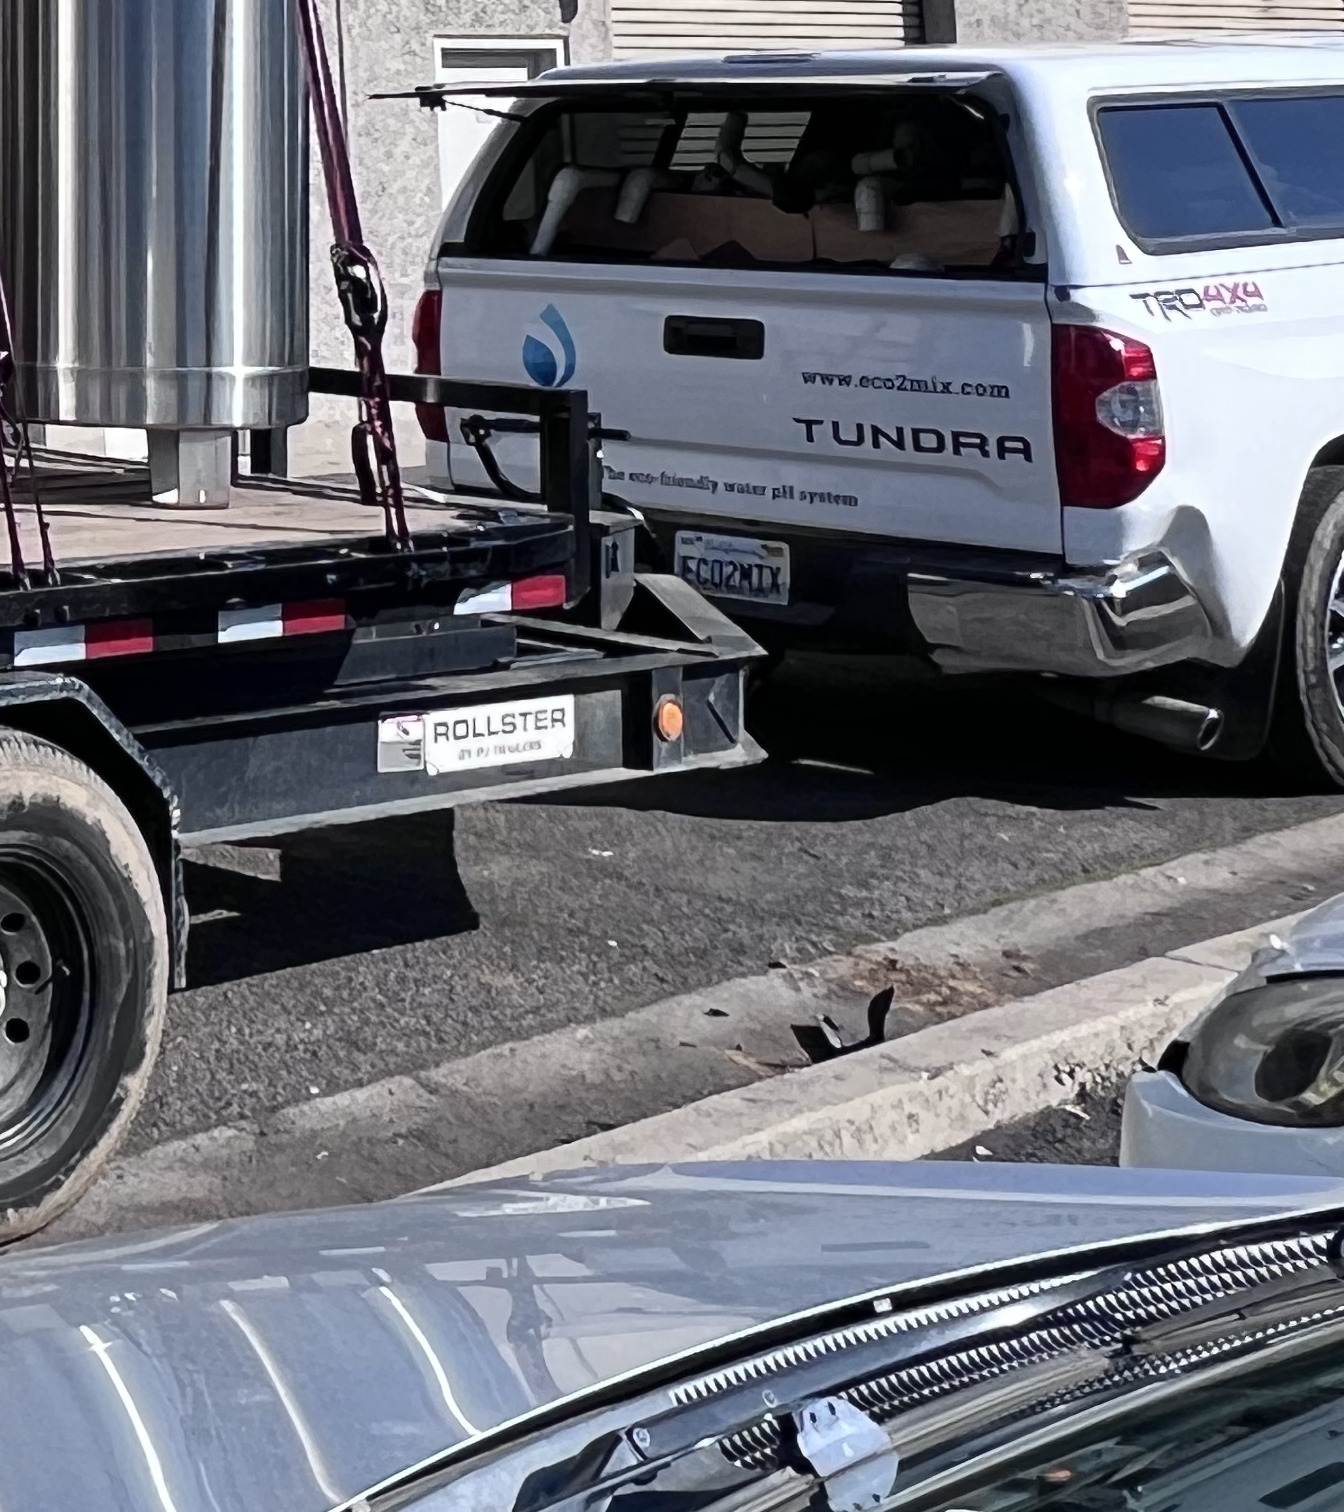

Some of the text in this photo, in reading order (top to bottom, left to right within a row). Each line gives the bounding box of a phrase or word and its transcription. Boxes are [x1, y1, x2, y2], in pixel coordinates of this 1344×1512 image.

[1129, 288, 1205, 322] TRD
[801, 371, 1010, 399] www.eco2mix.com
[792, 417, 1034, 463] TUNDRA
[724, 481, 766, 497] water
[799, 491, 859, 507] system
[680, 555, 782, 595] ECO2MIX
[433, 707, 567, 744] ROLLSTER
